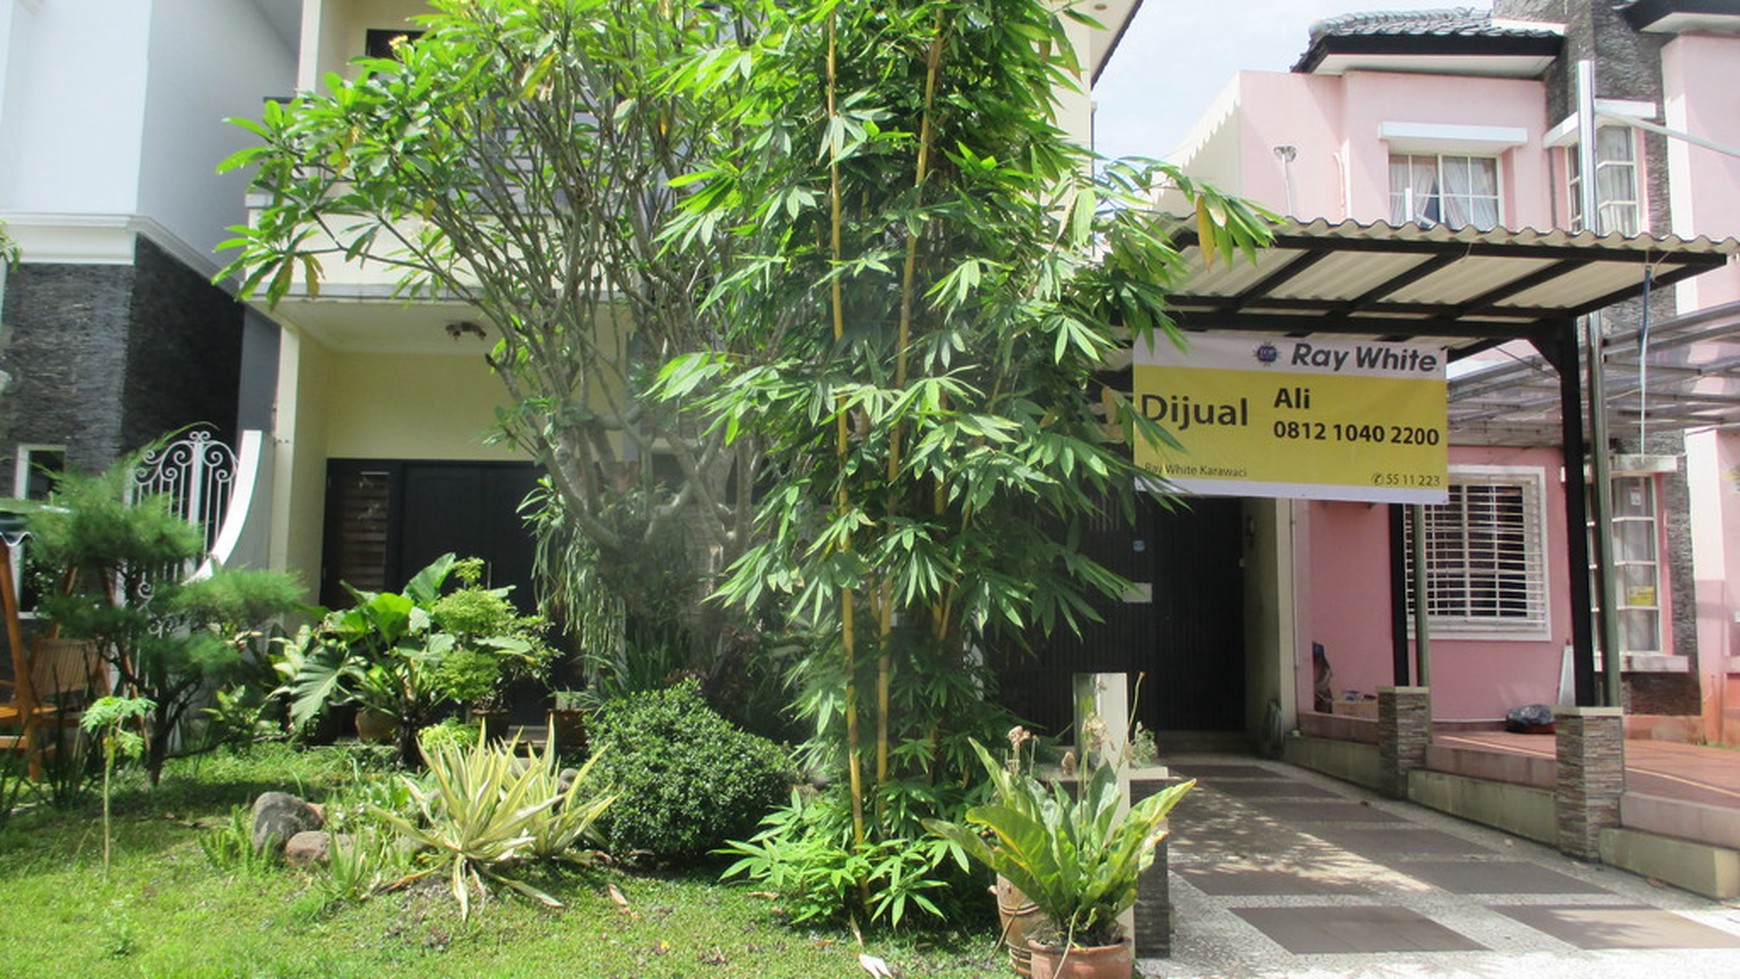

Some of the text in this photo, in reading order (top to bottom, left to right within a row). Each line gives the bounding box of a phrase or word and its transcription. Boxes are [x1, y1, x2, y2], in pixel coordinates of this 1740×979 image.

[1291, 343, 1349, 371] Ray
[1356, 346, 1437, 372] White
[1273, 387, 1310, 409] Ali
[1141, 394, 1248, 431] Dijual
[1273, 421, 1440, 446] 0812 1040 2200
[1165, 464, 1198, 476] White
[1200, 465, 1247, 477] Karawaci
[1386, 473, 1440, 487] 55 11 223
